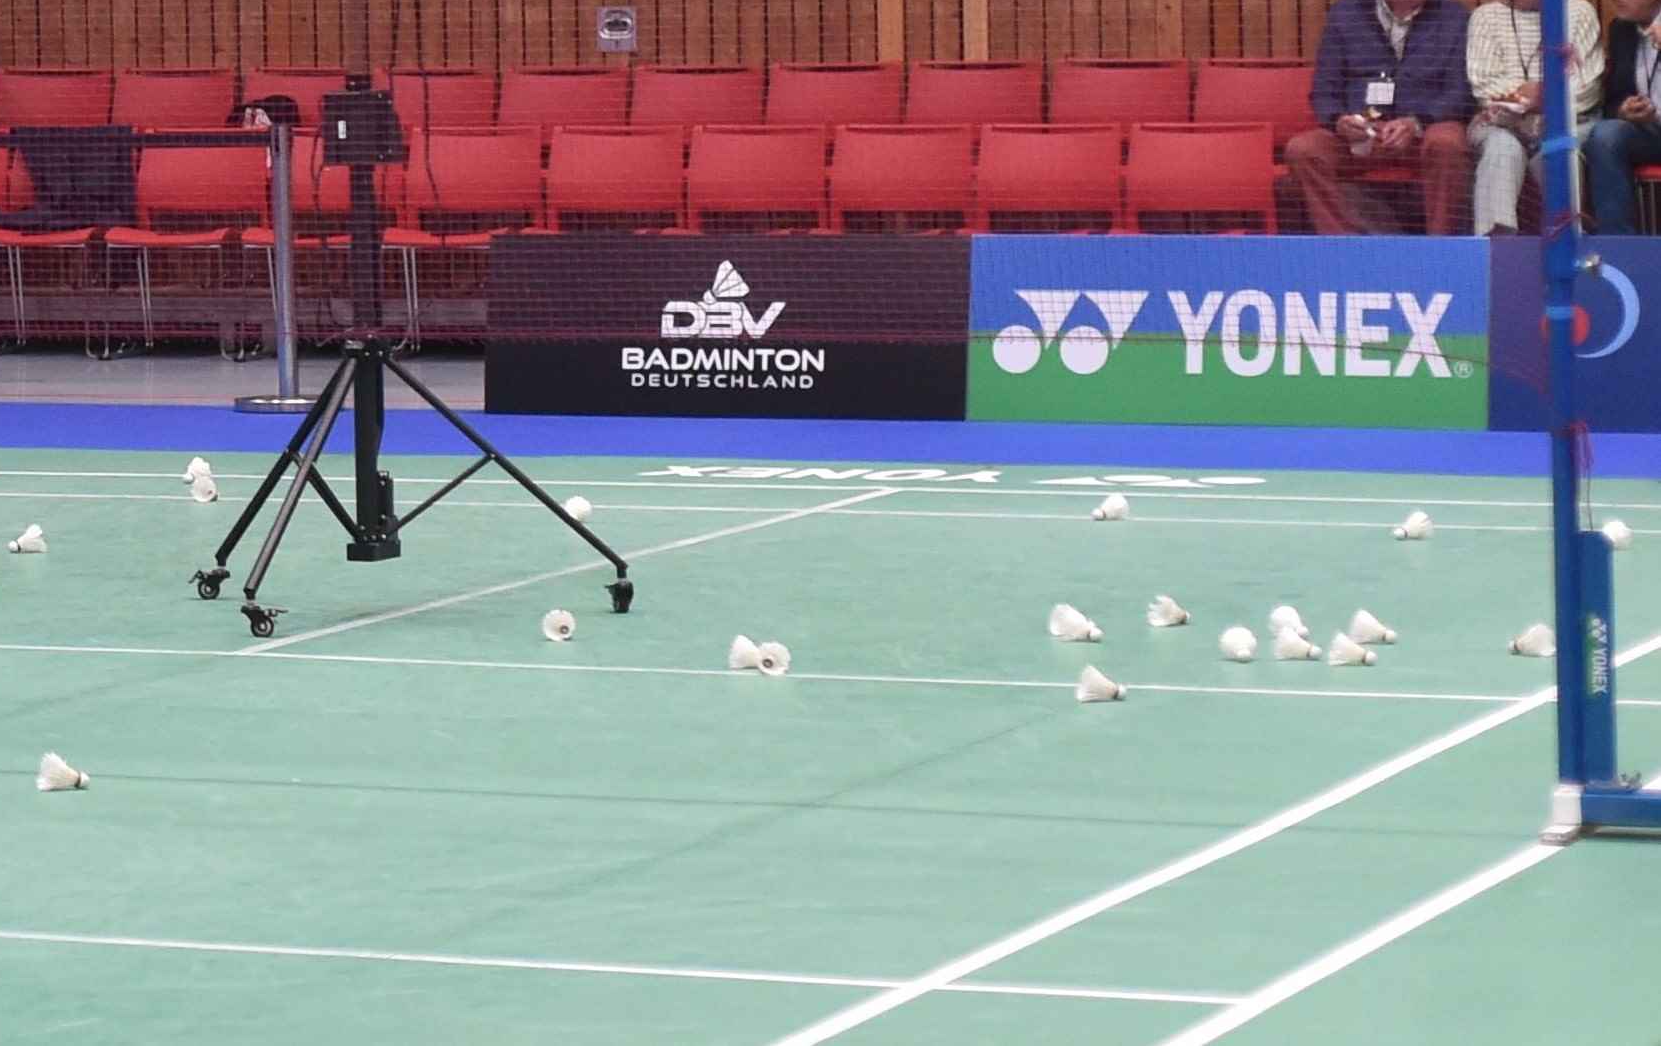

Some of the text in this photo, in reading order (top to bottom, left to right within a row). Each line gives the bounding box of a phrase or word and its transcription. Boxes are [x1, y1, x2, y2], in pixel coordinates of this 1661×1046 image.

[660, 300, 786, 339] DBV
[1167, 289, 1453, 378] YONEX
[621, 347, 825, 373] BADMINTON
[630, 373, 814, 390] DEUTSCHLAND
